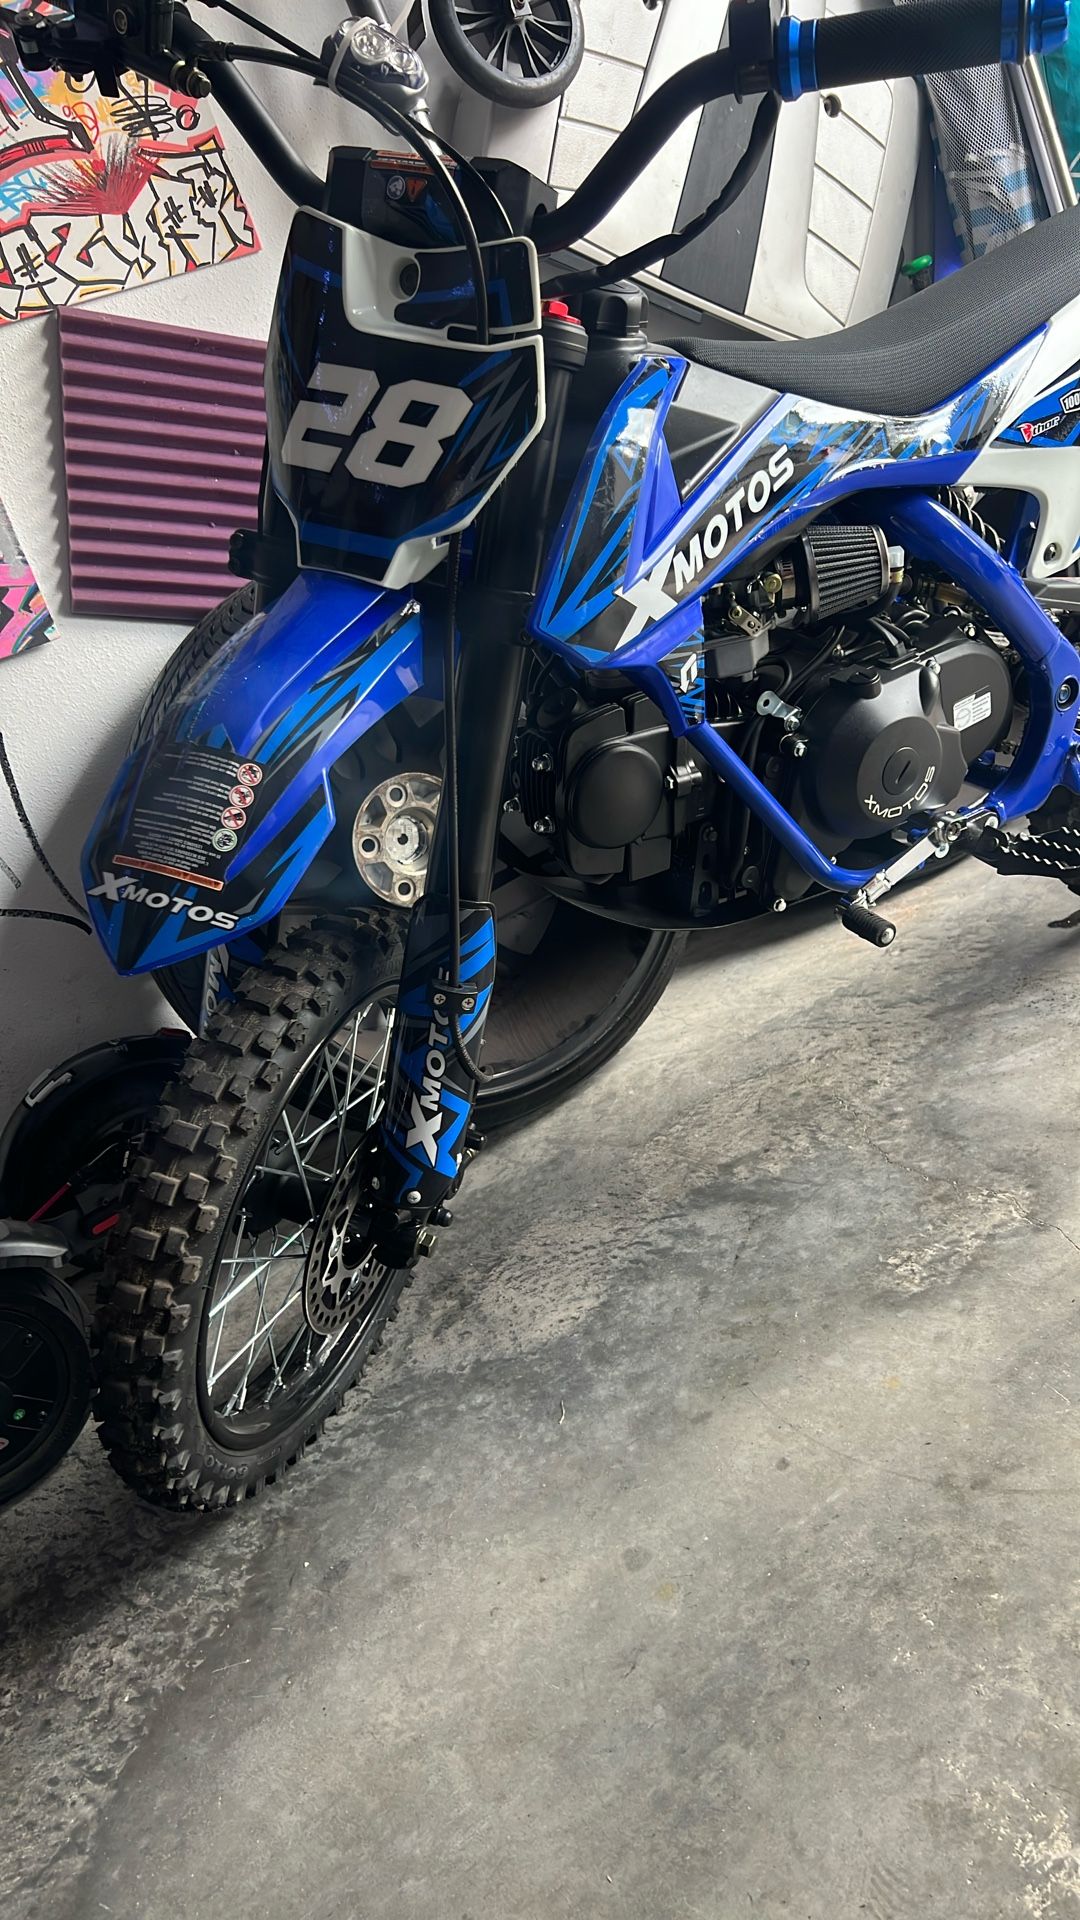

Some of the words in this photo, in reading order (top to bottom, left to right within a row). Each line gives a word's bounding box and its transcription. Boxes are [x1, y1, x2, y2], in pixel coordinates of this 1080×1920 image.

[281, 361, 474, 489] 28
[1063, 392, 1080, 410] 100
[614, 444, 795, 650] XMOTOS
[864, 765, 936, 819] XMOTOS
[88, 872, 240, 931] XMOTOS
